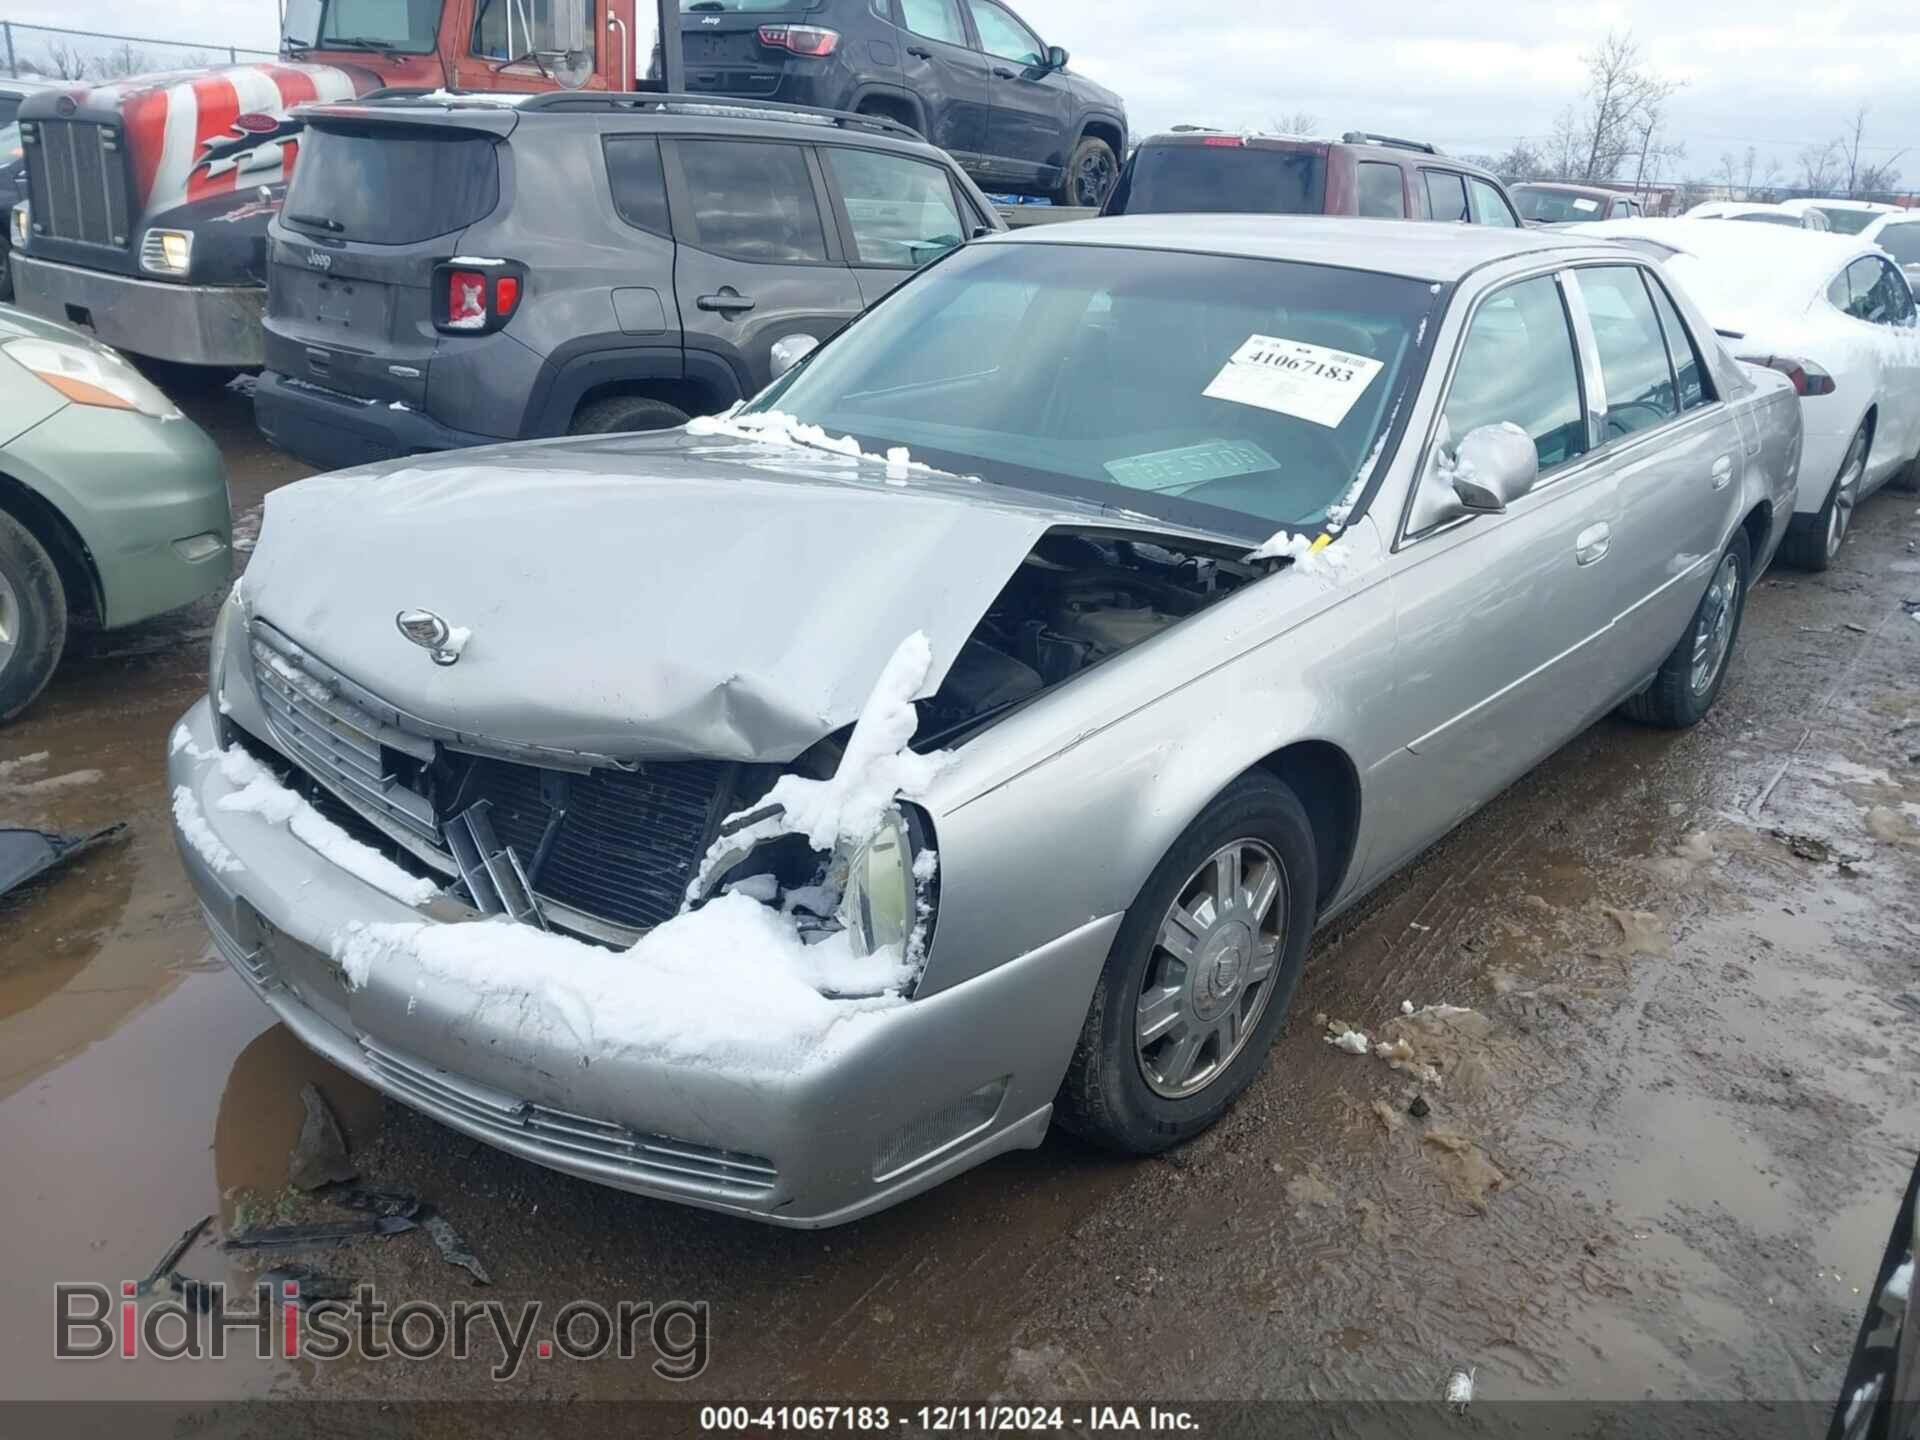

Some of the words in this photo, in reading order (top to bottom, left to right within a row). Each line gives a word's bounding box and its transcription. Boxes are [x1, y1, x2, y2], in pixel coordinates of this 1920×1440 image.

[701, 15, 721, 26] Jeep
[306, 248, 332, 271] Jeep
[1248, 350, 1355, 383] 41067183
